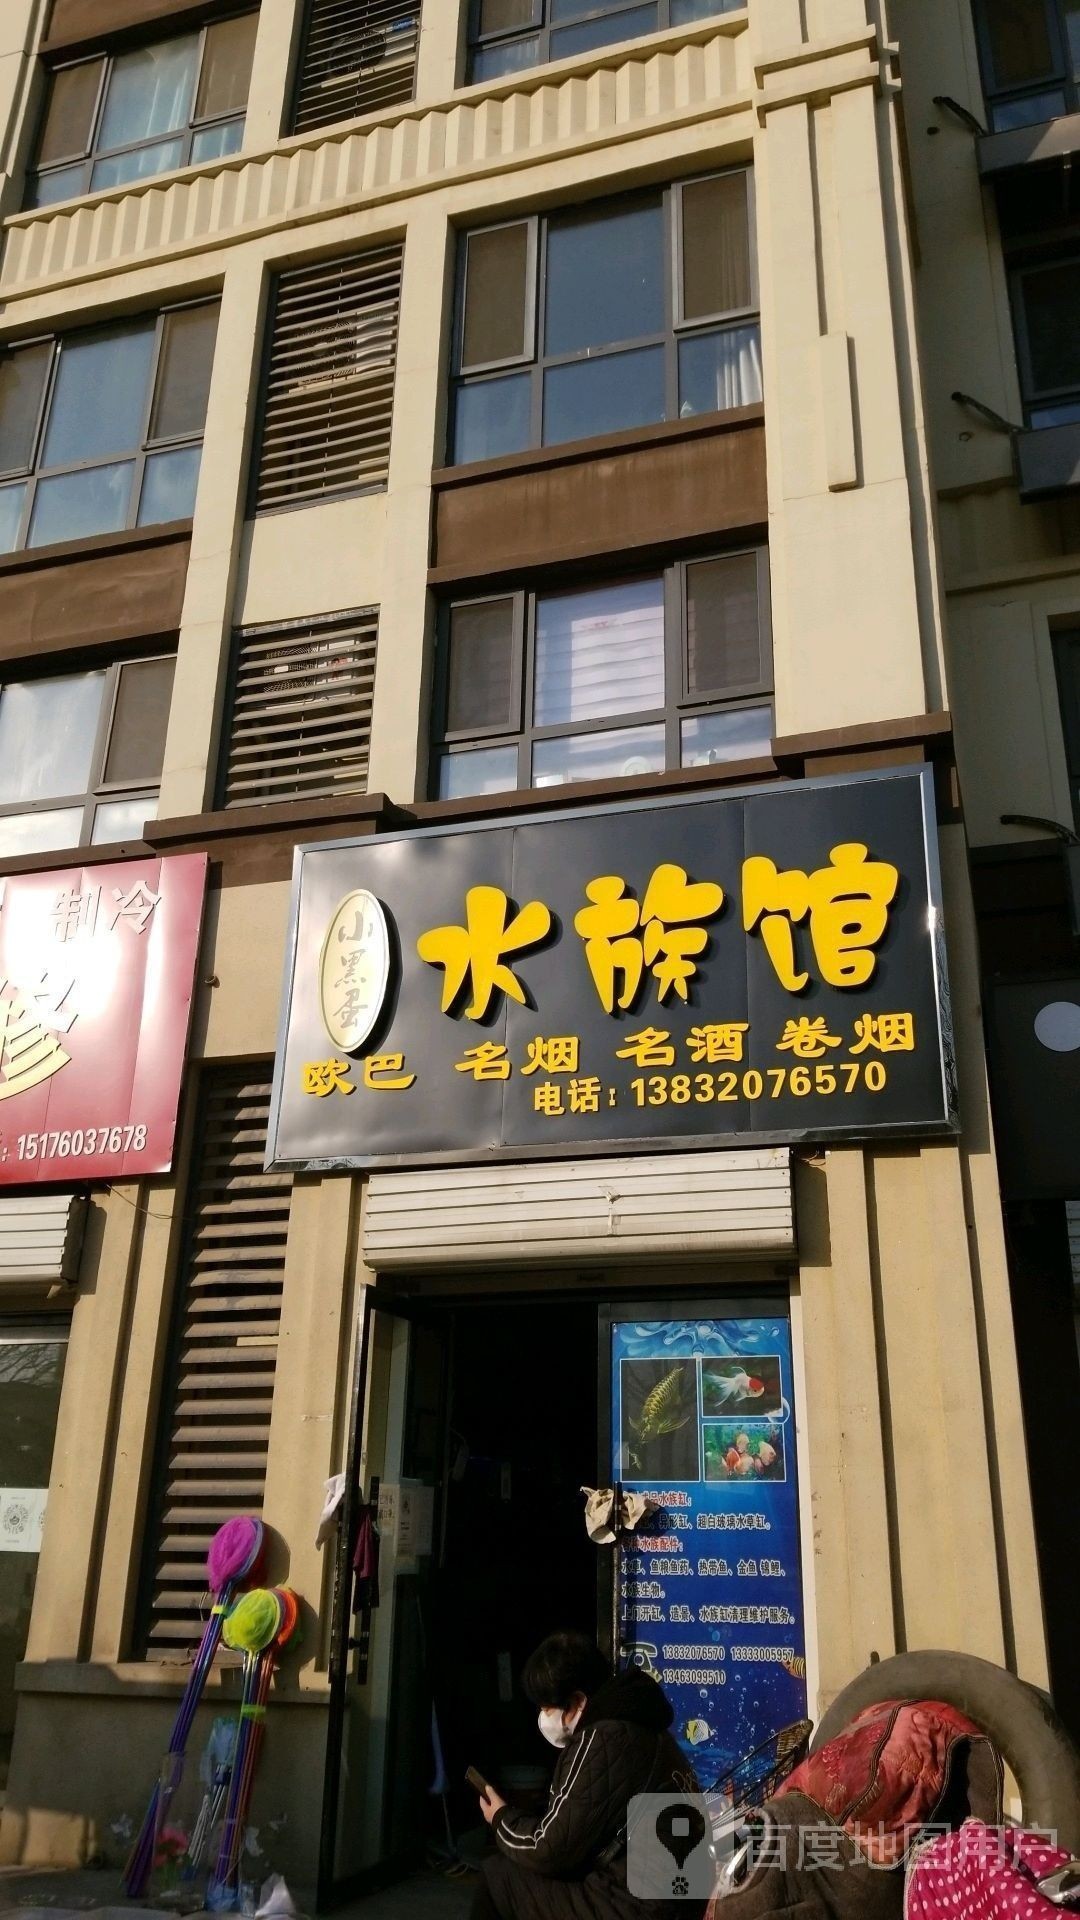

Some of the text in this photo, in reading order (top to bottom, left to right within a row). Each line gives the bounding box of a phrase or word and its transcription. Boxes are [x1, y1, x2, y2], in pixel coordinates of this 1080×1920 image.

[50, 879, 162, 941] 制冷
[417, 842, 899, 1021] 水族馆
[333, 910, 374, 1029] 小黑蛋
[303, 1012, 915, 1097] 欧巴 名烟 名酒 卷烟
[662, 1645, 726, 1661] 13832076570
[662, 1669, 727, 1685] 13463099510
